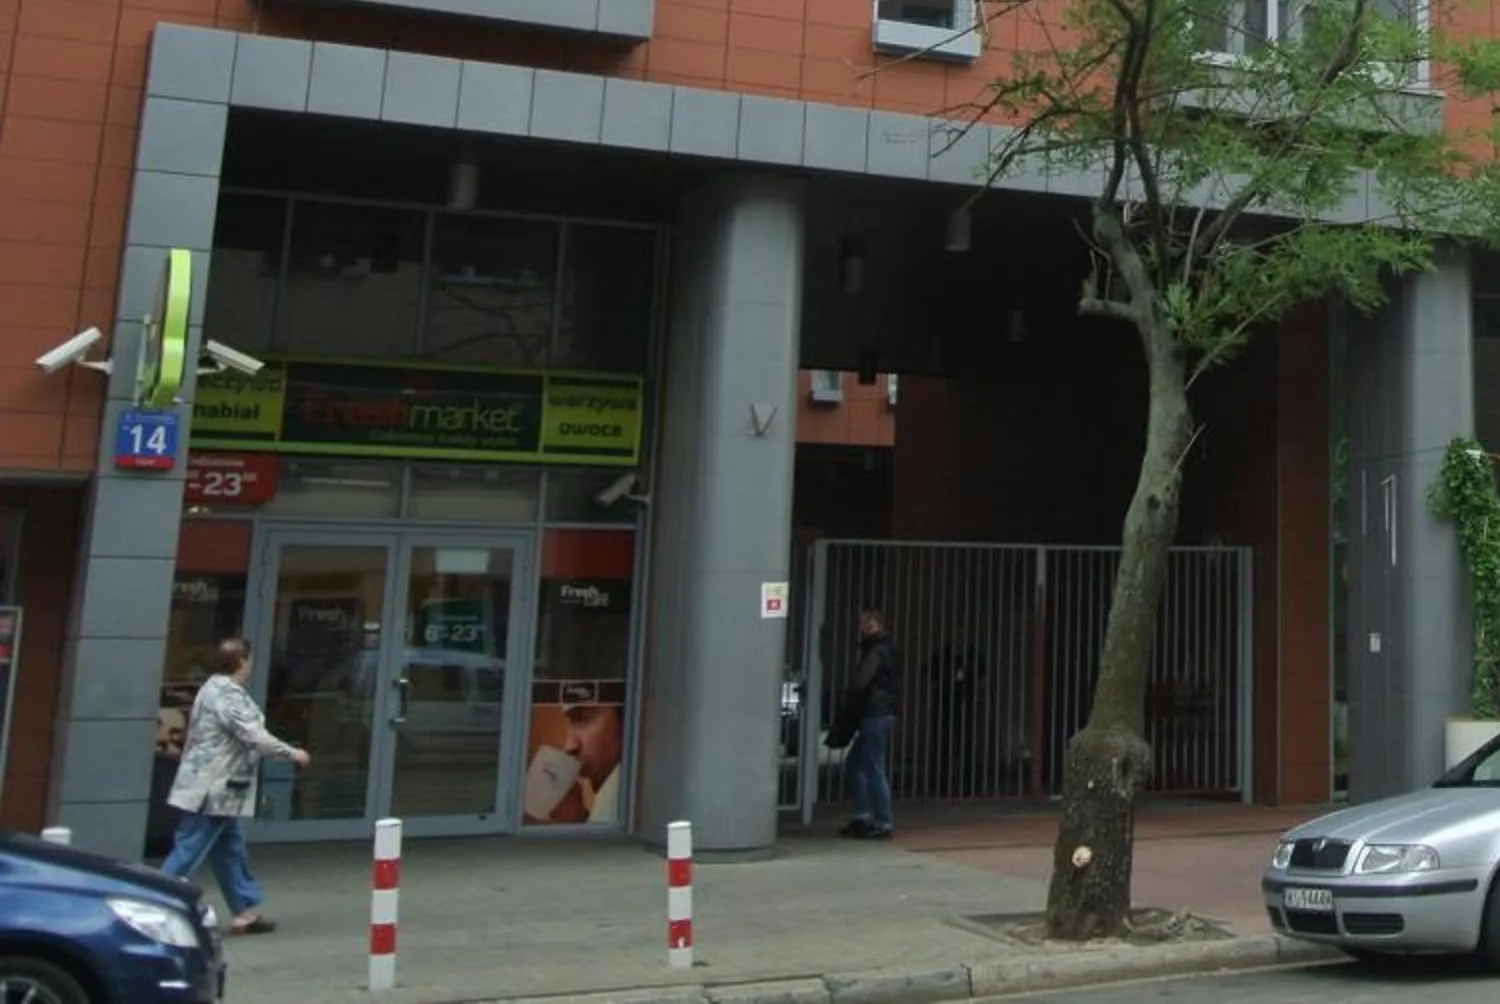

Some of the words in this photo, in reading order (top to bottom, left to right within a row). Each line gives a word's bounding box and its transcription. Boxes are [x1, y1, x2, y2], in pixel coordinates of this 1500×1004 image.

[197, 374, 281, 393] eczywo
[559, 422, 624, 438] owoce
[129, 423, 168, 455] 14
[561, 584, 599, 600] Fresh
